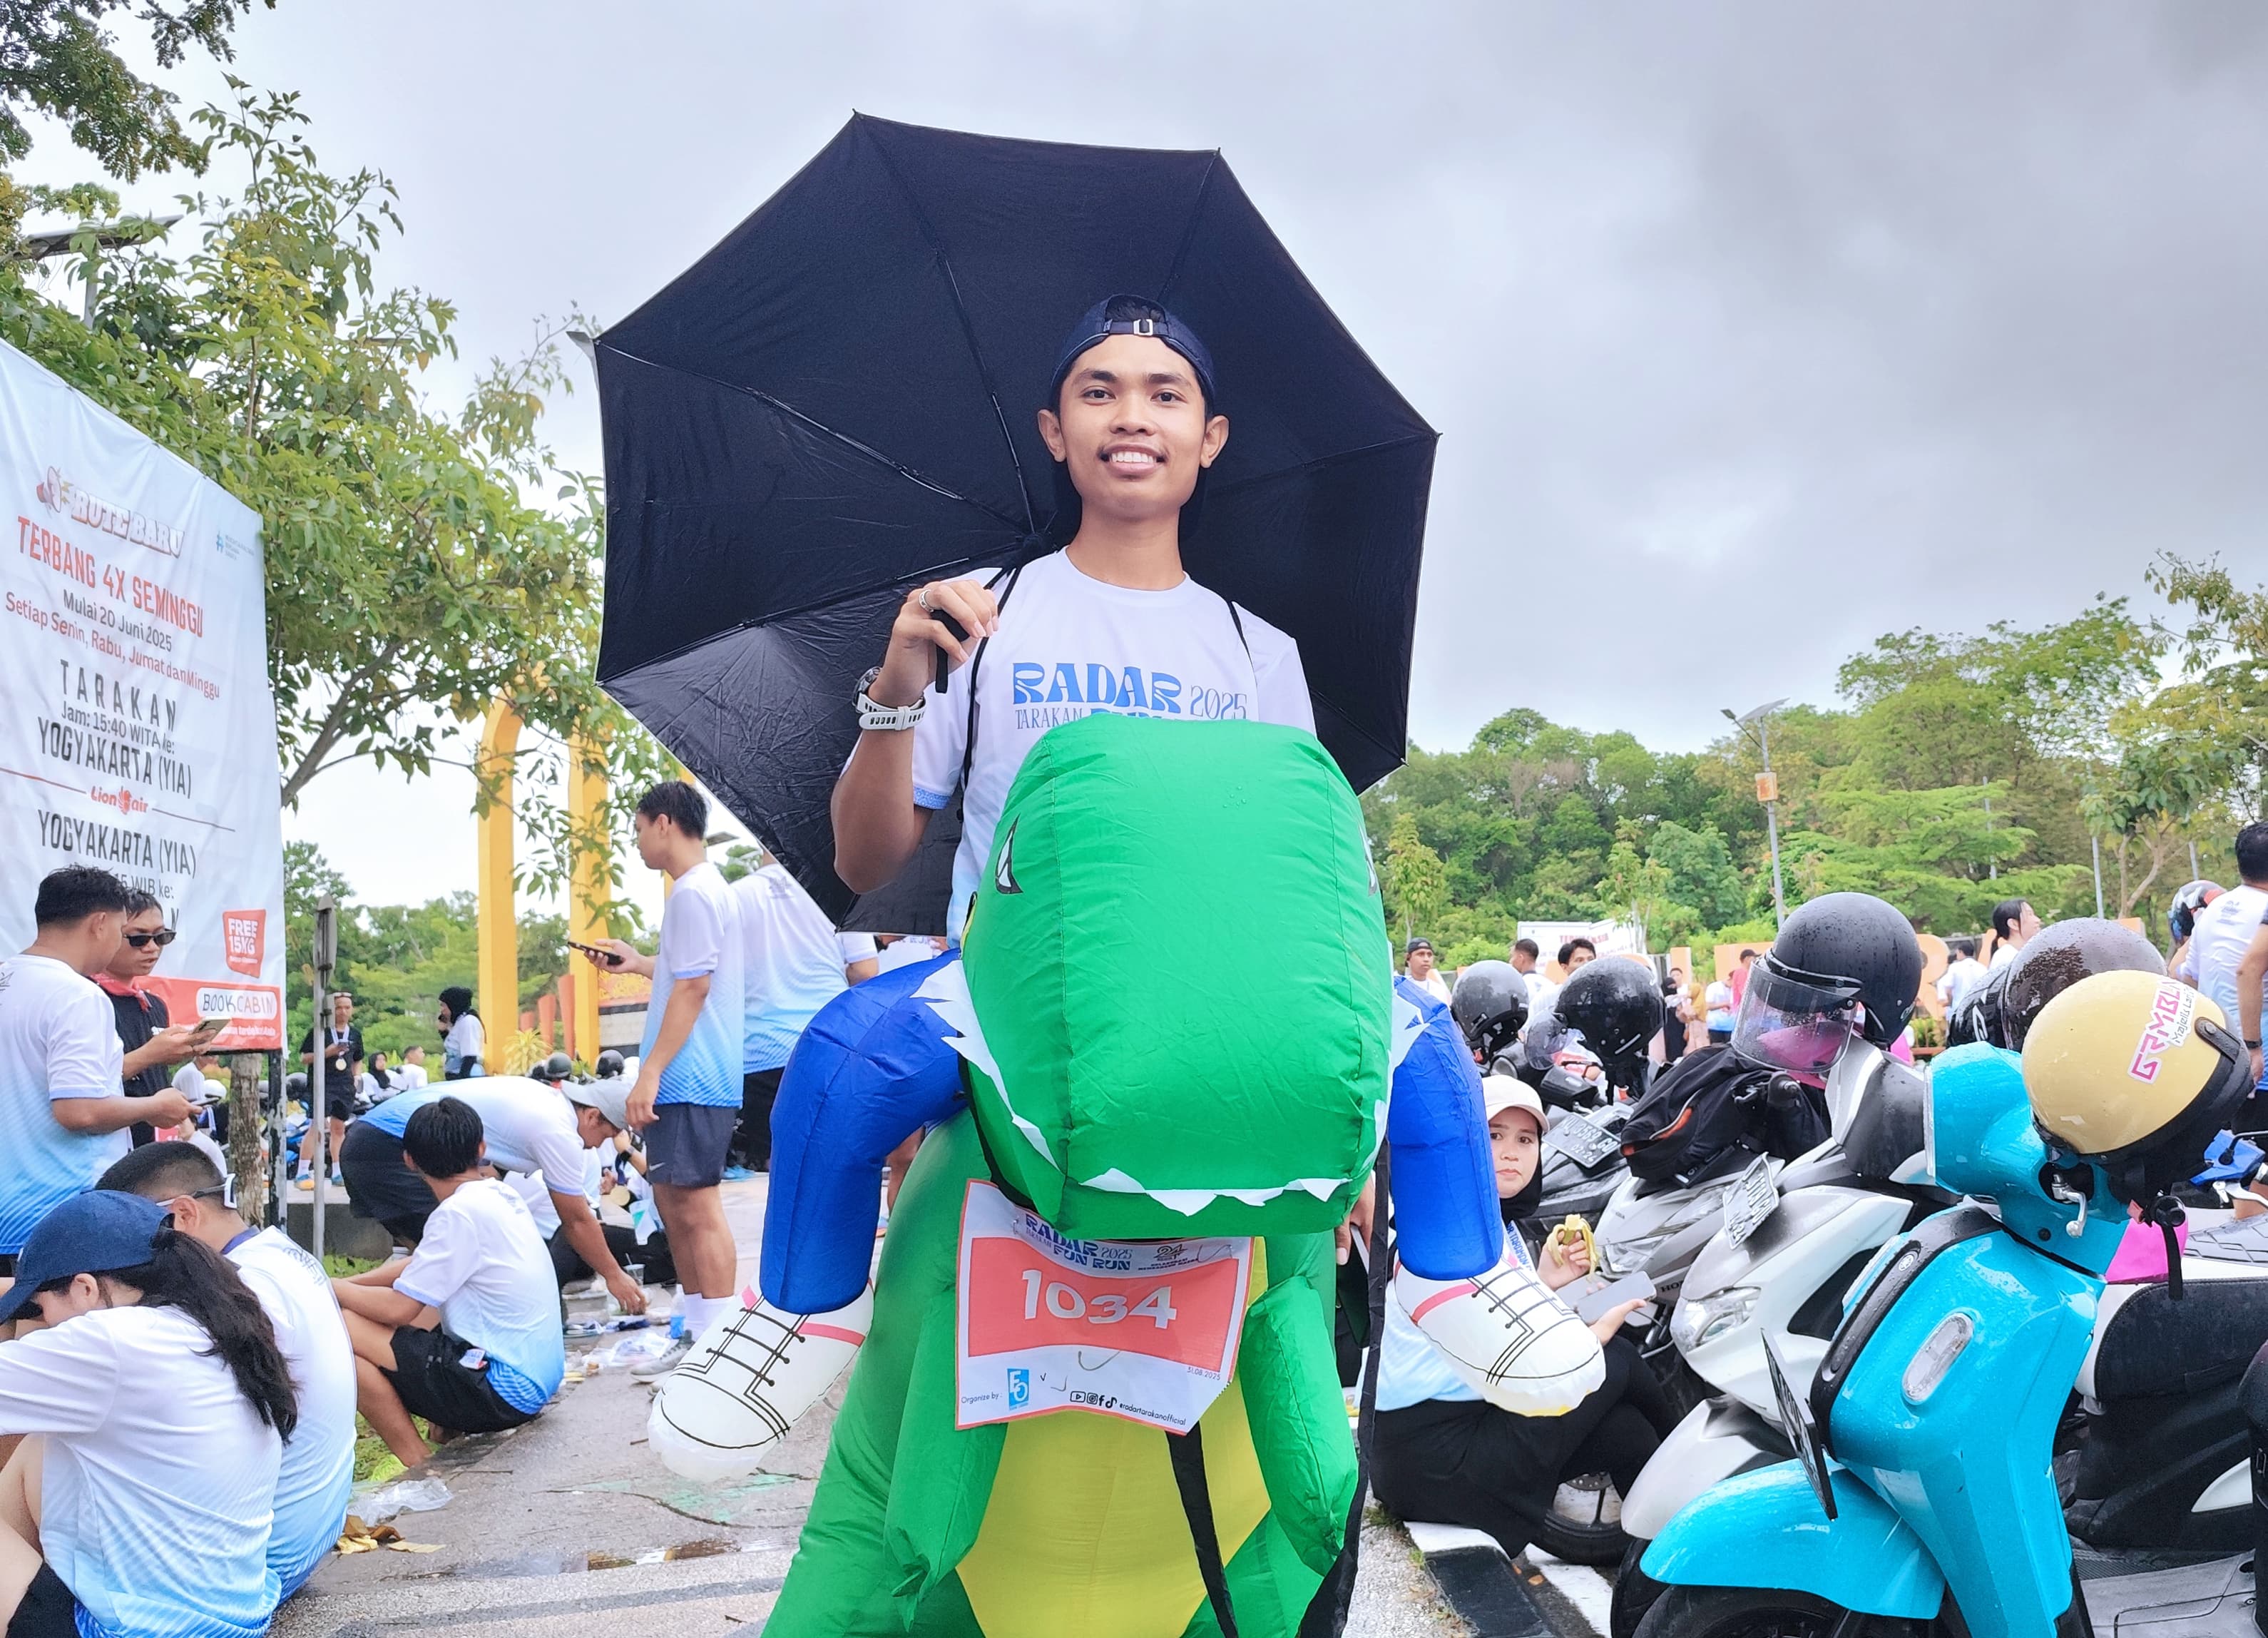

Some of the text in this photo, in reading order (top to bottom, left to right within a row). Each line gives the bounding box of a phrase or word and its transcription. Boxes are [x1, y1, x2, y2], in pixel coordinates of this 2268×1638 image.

[71, 488, 131, 540] RUTE
[130, 512, 185, 559] BARU
[18, 516, 203, 638] TERBANG 4X SEMINGGU
[6, 591, 48, 631] Setiap
[51, 611, 88, 648] Senin,
[91, 630, 126, 663] Rabu,
[129, 646, 165, 675] Jumat
[63, 589, 172, 652] Mulai 20 Juni 2025
[61, 658, 176, 733] TARAKAN
[1013, 662, 1247, 720] RADAR 2025
[38, 716, 191, 799] YOGYAKARTA (YIA)
[61, 701, 175, 755] Jam: 15:40 WITA ke:
[91, 786, 148, 813] Lion air
[38, 809, 196, 879] YOGYAKARTA (YIA)
[159, 879, 175, 899] ke:
[228, 917, 257, 938] FREE
[1026, 1214, 1133, 1260] RADAR 2025
[1053, 1245, 1088, 1266] FUN
[1093, 1258, 1130, 1271] RUN
[1021, 1269, 1177, 1329] 1034
[961, 1394, 990, 1404] Organize
